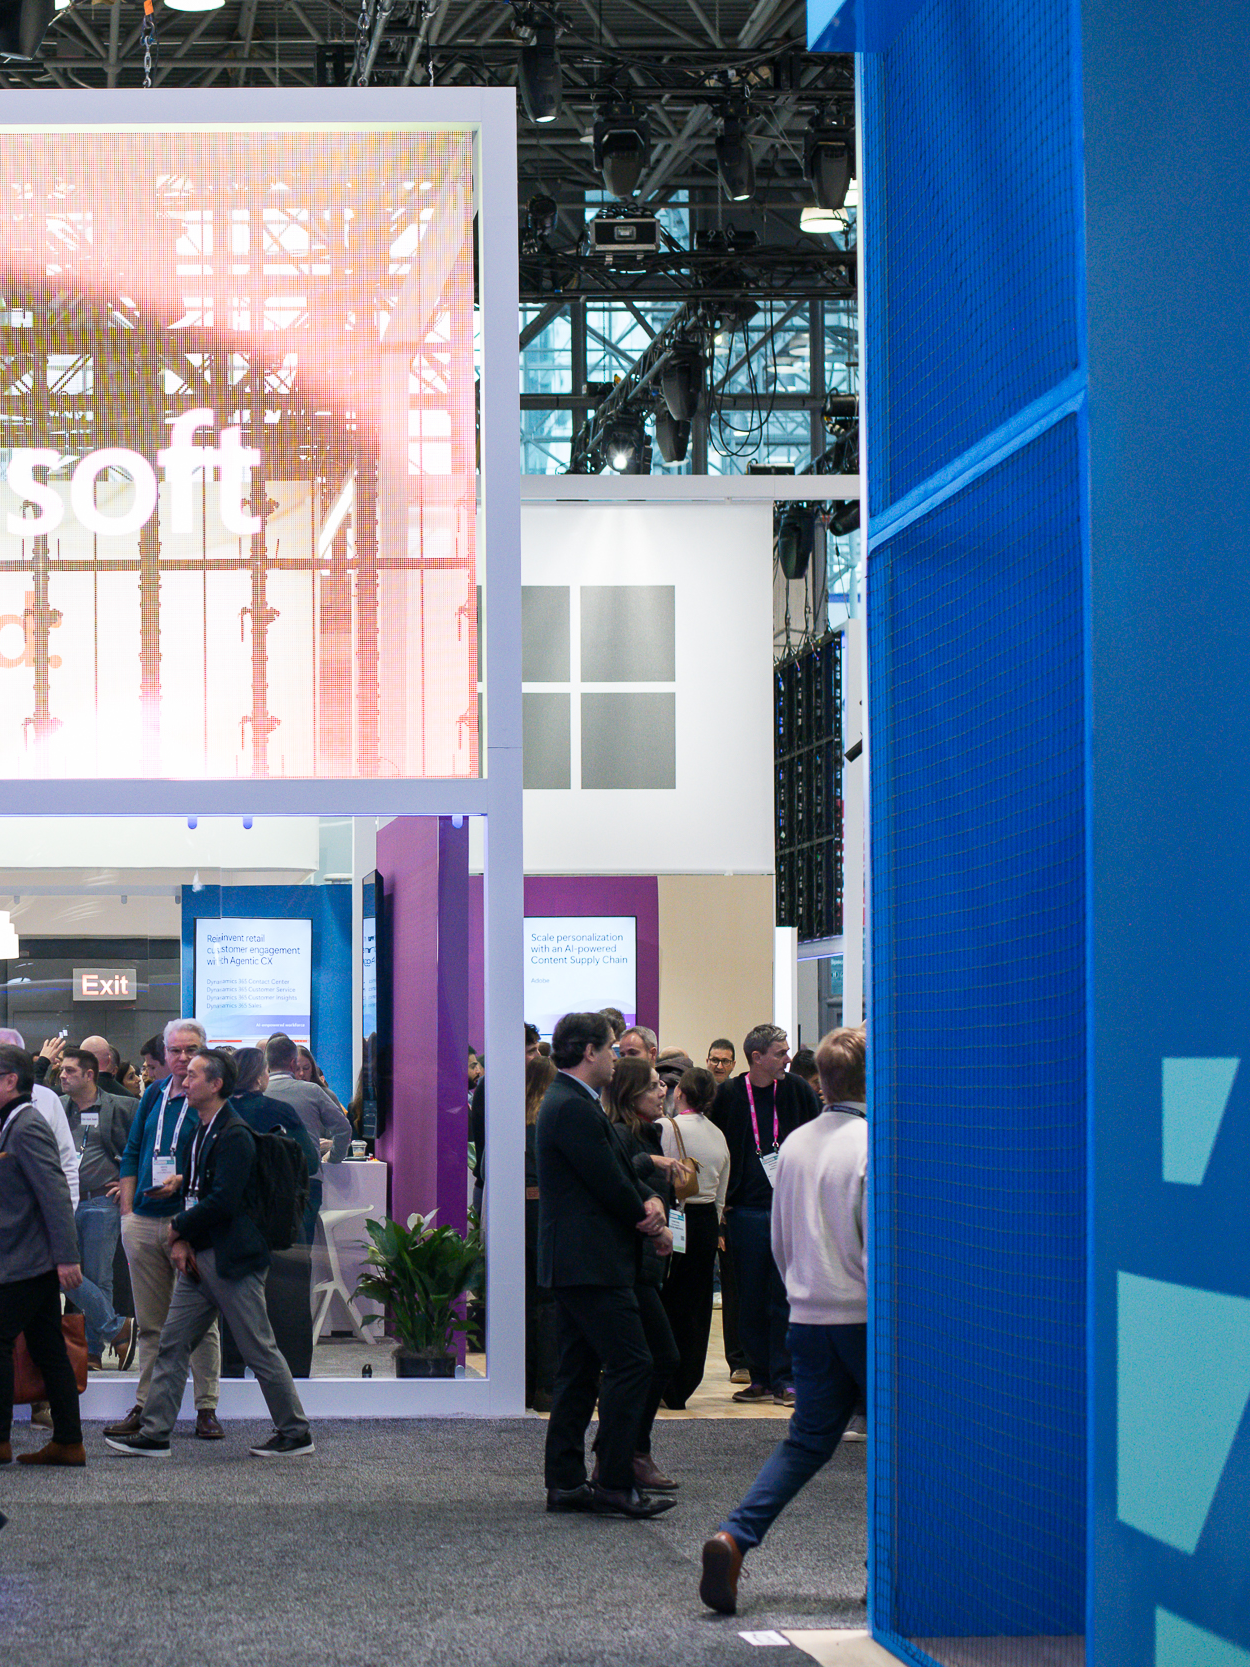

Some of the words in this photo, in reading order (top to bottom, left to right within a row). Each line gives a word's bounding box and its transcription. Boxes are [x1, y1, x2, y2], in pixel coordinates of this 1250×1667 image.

[245, 934, 266, 943] retail
[531, 933, 555, 942] Scale
[556, 932, 624, 944] personalization
[249, 947, 301, 957] engagement
[530, 944, 550, 953] with
[564, 944, 617, 954] AI-powered
[229, 956, 259, 967] Agentic
[260, 956, 274, 966] CX
[530, 955, 568, 964] Content
[570, 955, 600, 966] Supply
[602, 955, 628, 964] Chain
[81, 974, 129, 996] Exit
[275, 994, 298, 1002] Insights
